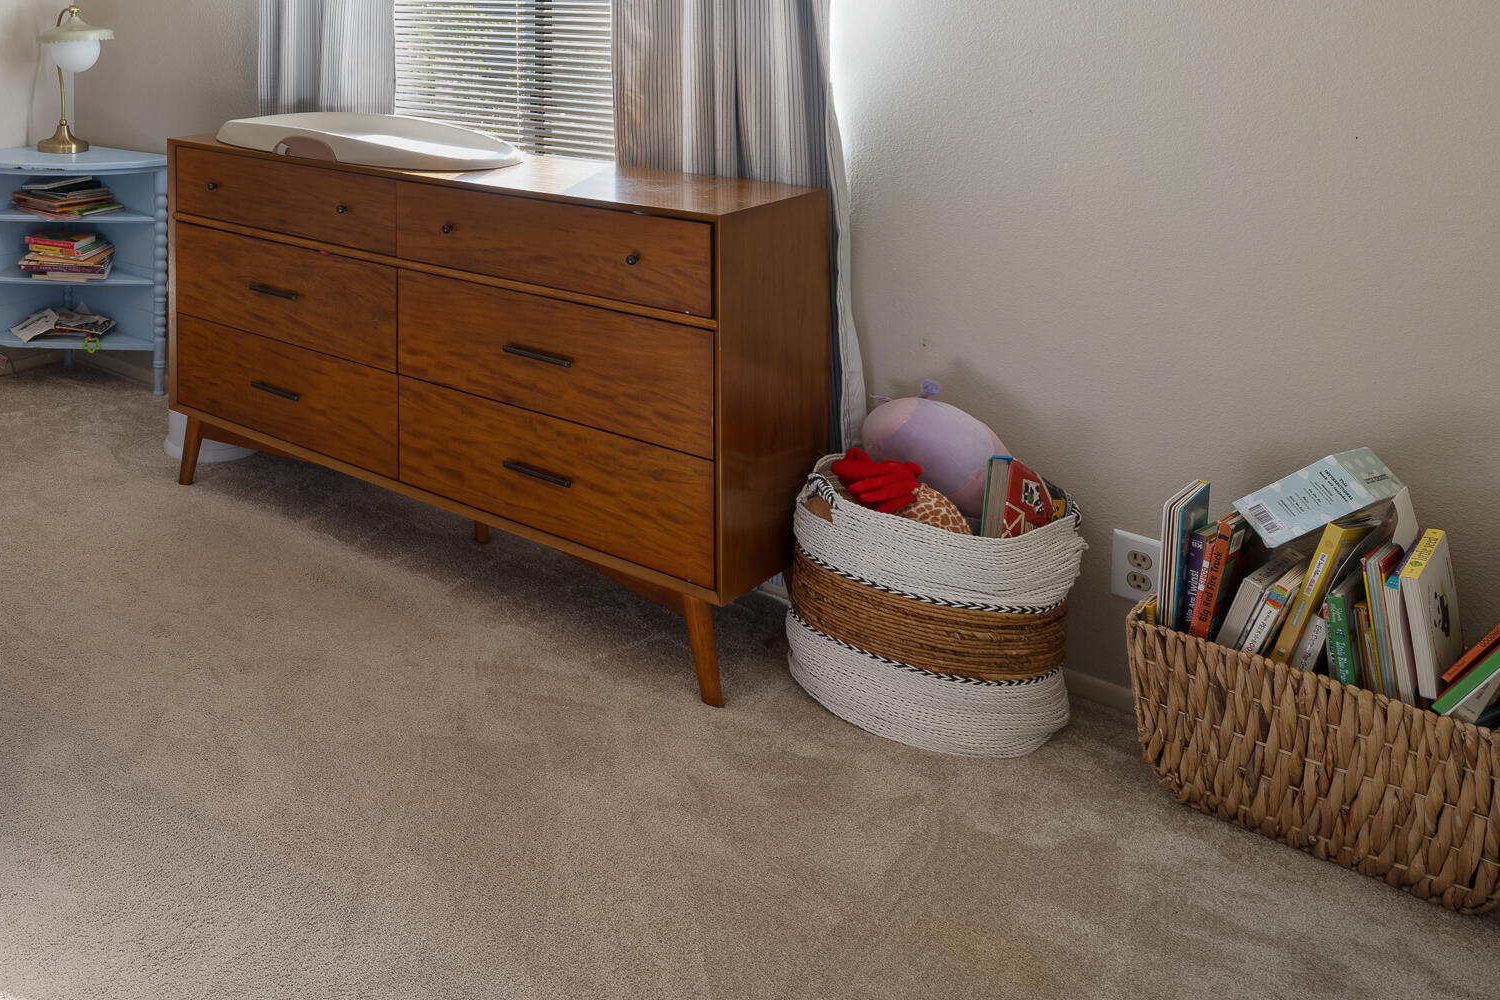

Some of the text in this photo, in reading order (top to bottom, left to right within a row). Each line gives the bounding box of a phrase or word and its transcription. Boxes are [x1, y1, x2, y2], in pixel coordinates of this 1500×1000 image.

[1188, 569, 1199, 596] Twins!
[1198, 552, 1222, 623] Big Red Fire Truck
